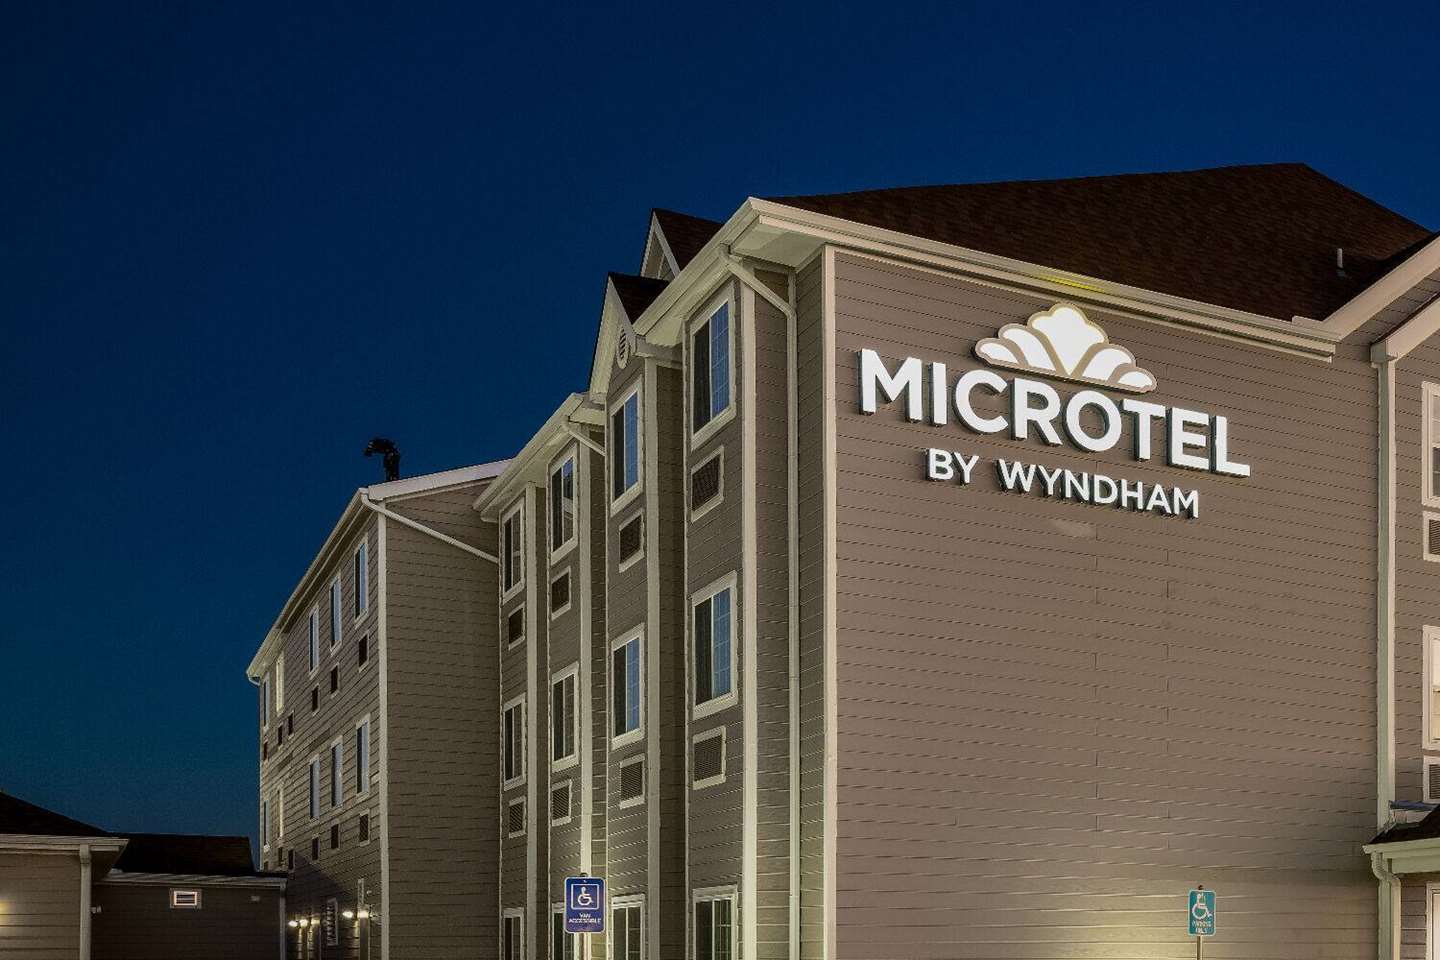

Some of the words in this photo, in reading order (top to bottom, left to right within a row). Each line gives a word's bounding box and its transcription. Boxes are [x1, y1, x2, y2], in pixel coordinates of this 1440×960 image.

[860, 347, 1250, 477] MICROTEL
[926, 447, 979, 484] BY
[998, 458, 1199, 519] WYNDHAM
